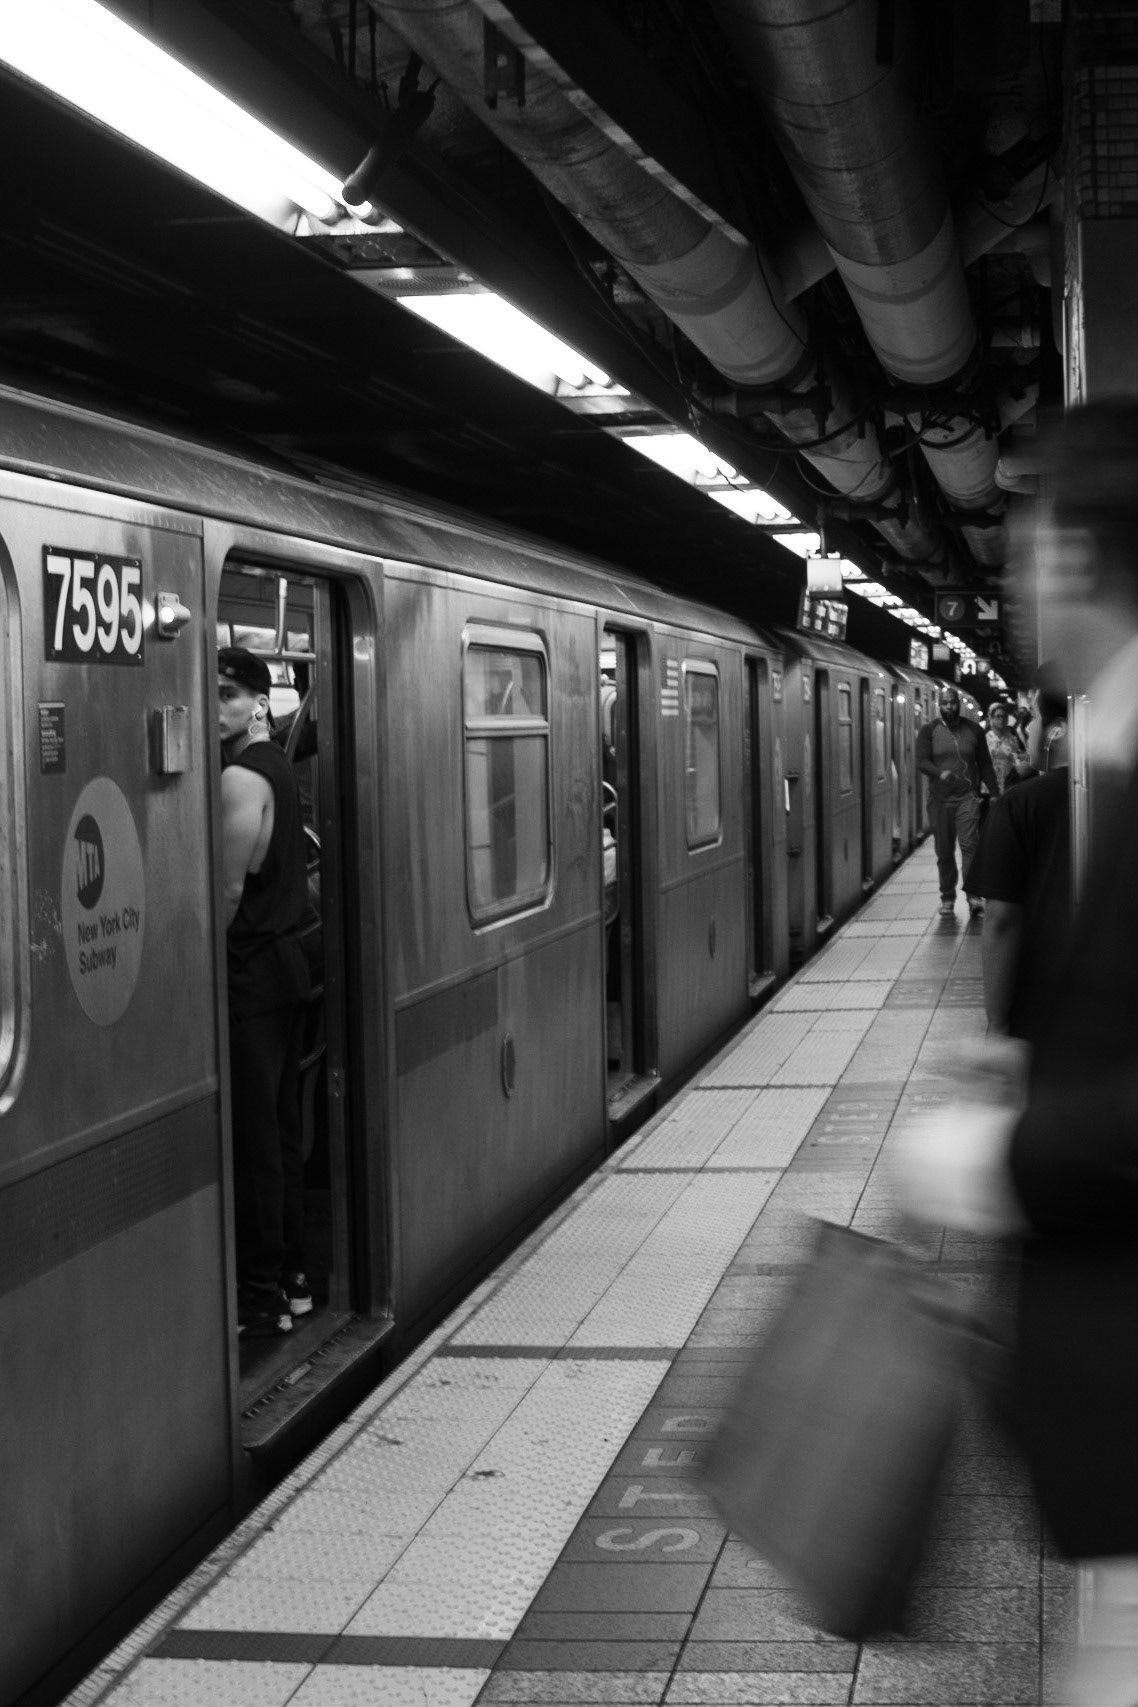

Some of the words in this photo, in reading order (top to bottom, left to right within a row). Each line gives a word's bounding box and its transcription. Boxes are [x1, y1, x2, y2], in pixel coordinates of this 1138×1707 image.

[47, 555, 142, 655] 7595
[947, 602, 958, 616] 7
[74, 838, 100, 892] MTA
[78, 921, 98, 945] New
[100, 912, 121, 938] York
[122, 907, 139, 932] City
[79, 947, 116, 975] Subway
